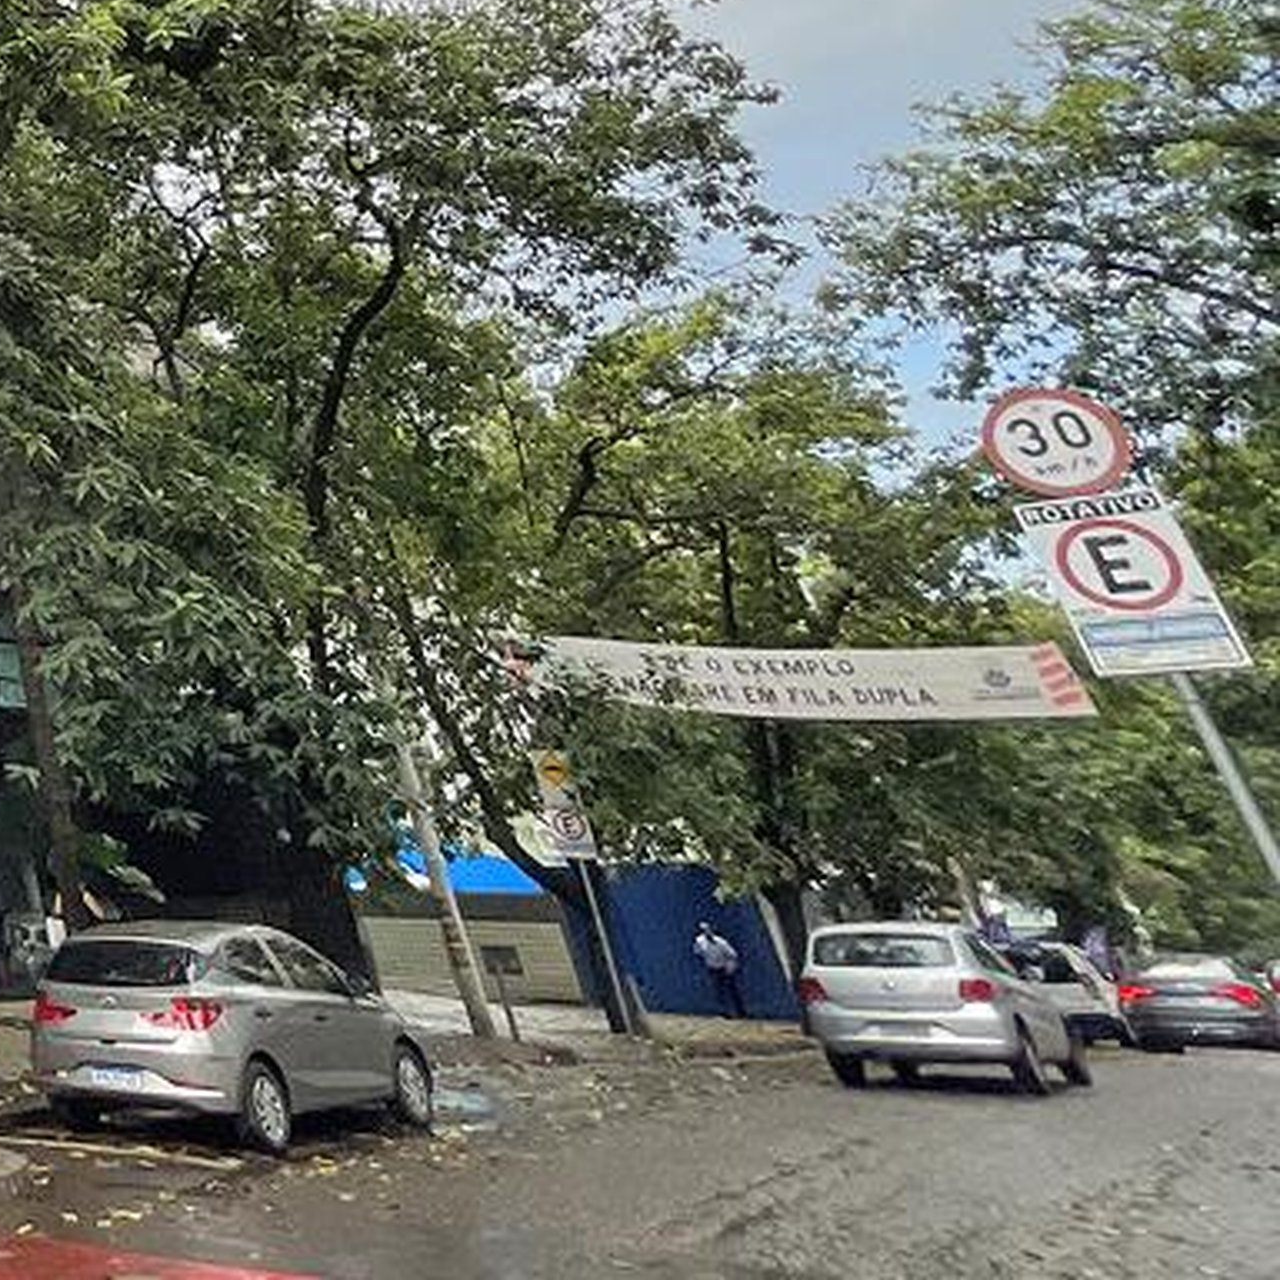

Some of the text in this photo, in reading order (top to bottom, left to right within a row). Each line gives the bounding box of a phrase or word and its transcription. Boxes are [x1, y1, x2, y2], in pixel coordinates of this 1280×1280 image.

[1007, 411, 1092, 457] 30
[1022, 493, 1156, 524] ROTATIVO
[1084, 534, 1152, 594] E
[733, 658, 855, 677] EXEMPLO
[743, 686, 777, 704] EM
[787, 686, 844, 706] FILA
[852, 687, 938, 706] DUPLA
[562, 816, 578, 834] E
